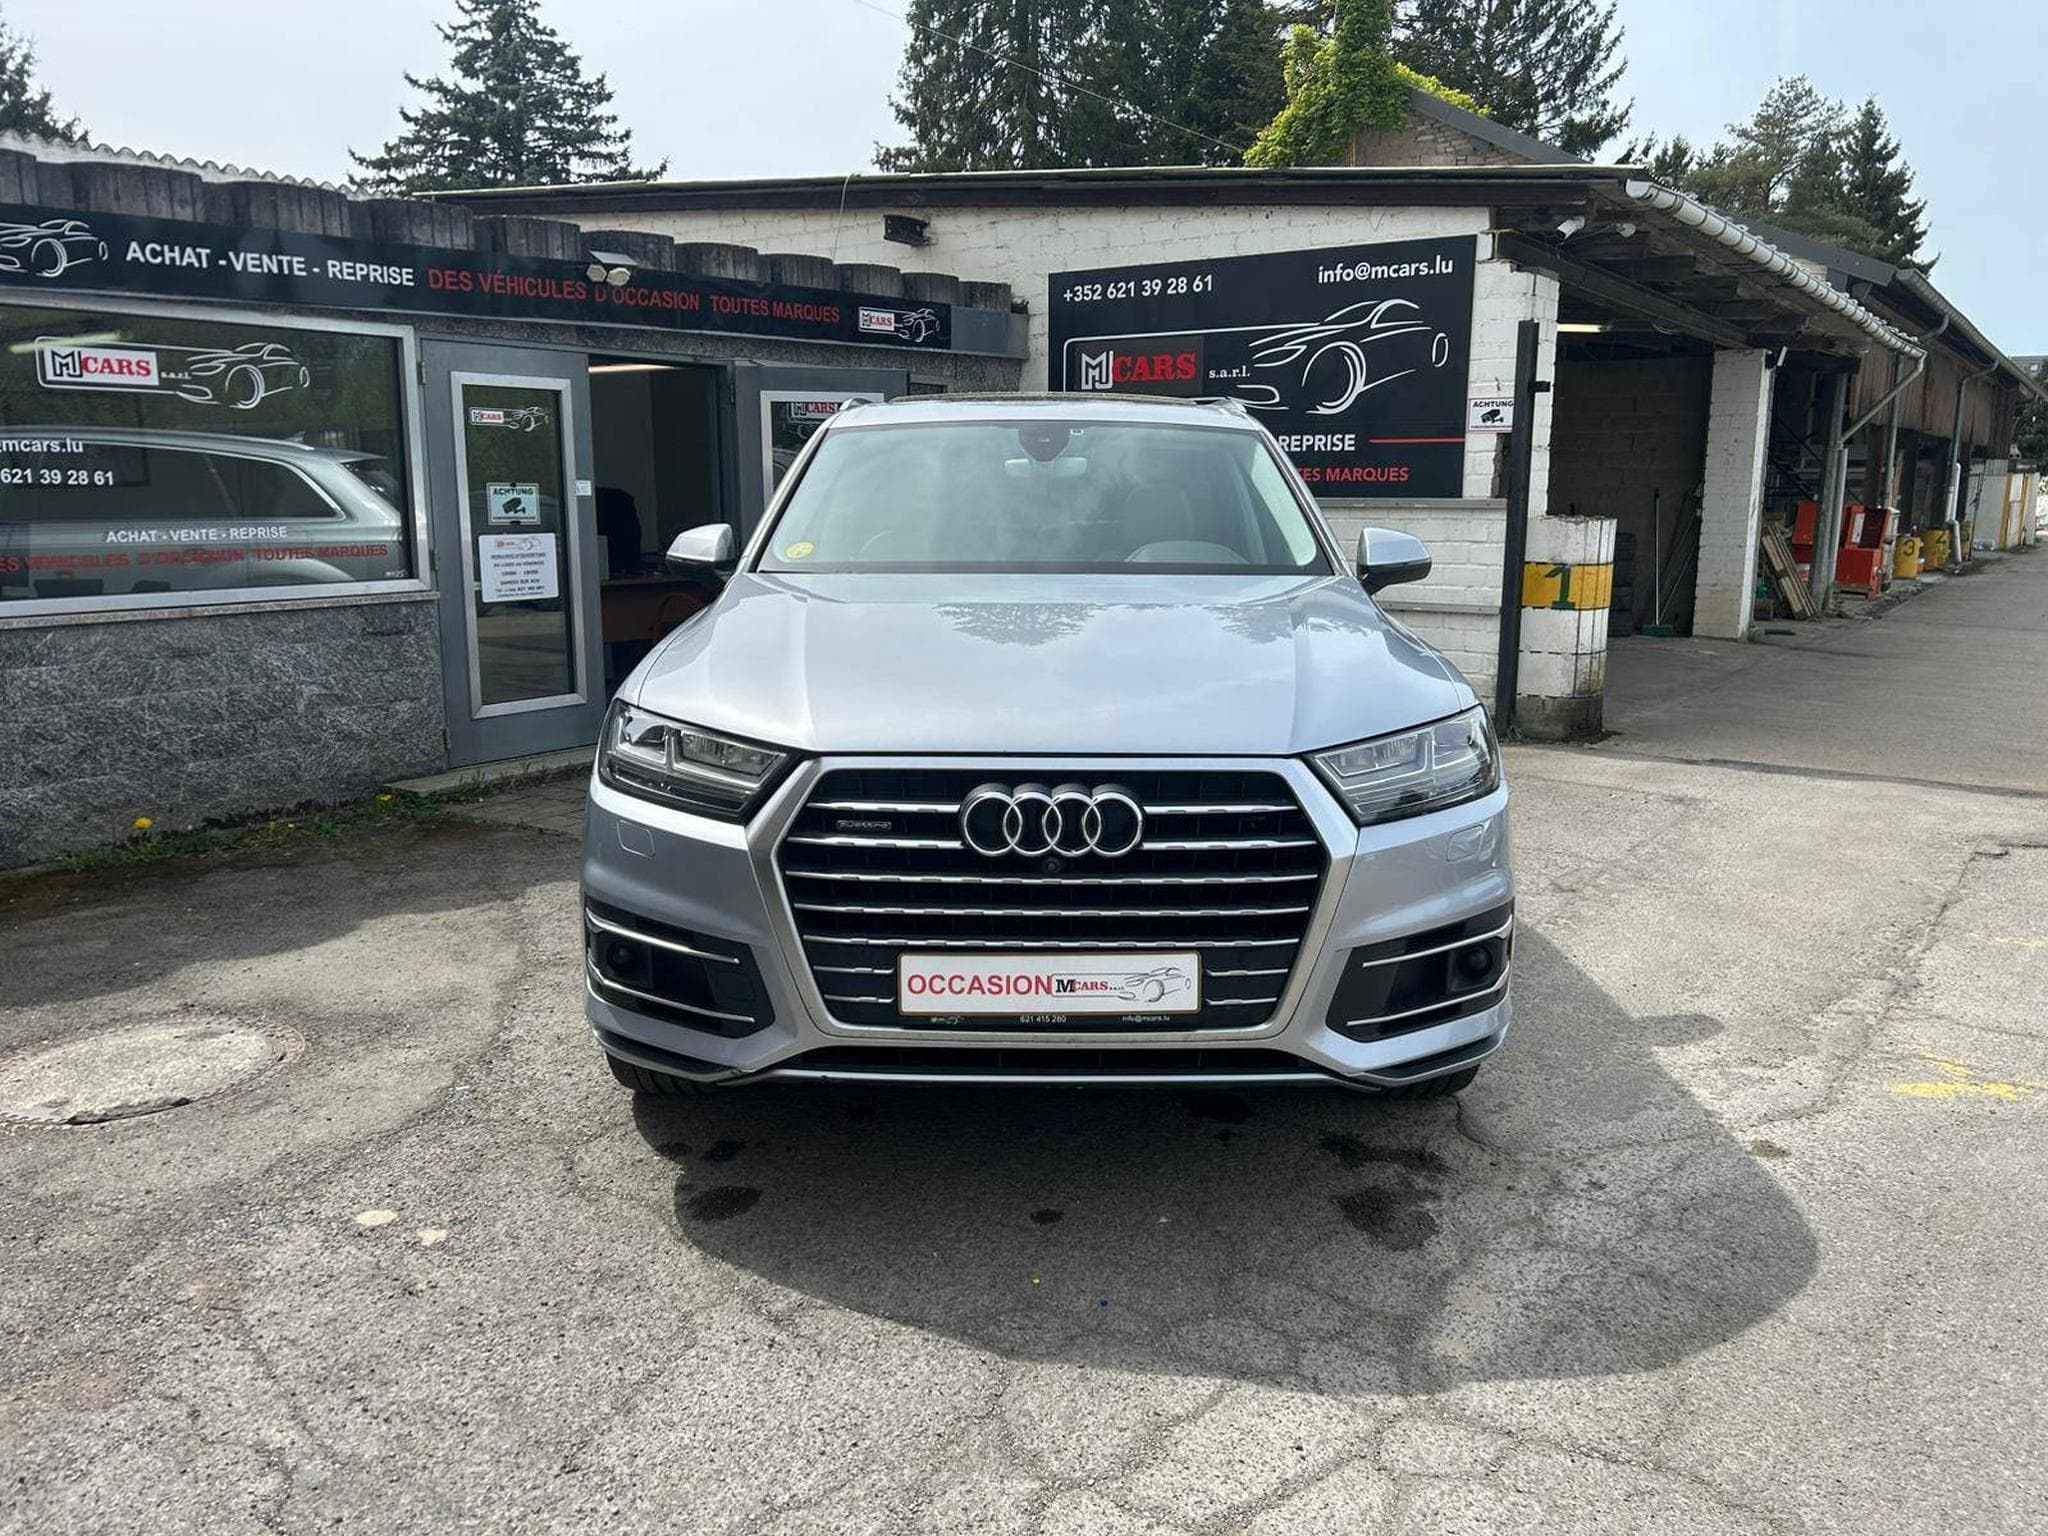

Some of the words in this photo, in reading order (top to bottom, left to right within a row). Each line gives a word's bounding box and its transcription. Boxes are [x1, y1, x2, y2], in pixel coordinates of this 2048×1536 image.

[1318, 254, 1454, 284] info@mcars.lu
[126, 241, 211, 269] ACHAT
[327, 260, 415, 286] REPRISE
[428, 268, 473, 292] DES
[477, 269, 586, 300] VÉHICULES
[710, 295, 768, 316] TOUTES
[773, 302, 840, 322] MARQUES
[1064, 284, 1103, 302] +352
[1106, 281, 1136, 299] 621
[1141, 279, 1162, 296] 39
[1167, 277, 1188, 294] 28
[1192, 274, 1213, 292] 61
[1473, 400, 1515, 408] ACHTUNG
[0, 438, 83, 453] mcars.lu
[1279, 434, 1356, 452] REPRISE
[0, 468, 32, 484] 621
[40, 469, 62, 484] 39
[67, 469, 89, 485] 28
[94, 470, 114, 485] 61
[1326, 466, 1409, 481] MARQUES
[492, 488, 534, 496] ACHTUNG
[106, 530, 157, 543] ACHAT
[169, 528, 218, 541] VENTE
[230, 526, 288, 540] REPRISE
[1903, 539, 1915, 557] 3
[1544, 566, 1577, 609] 1
[907, 974, 1053, 995] OCCASION
